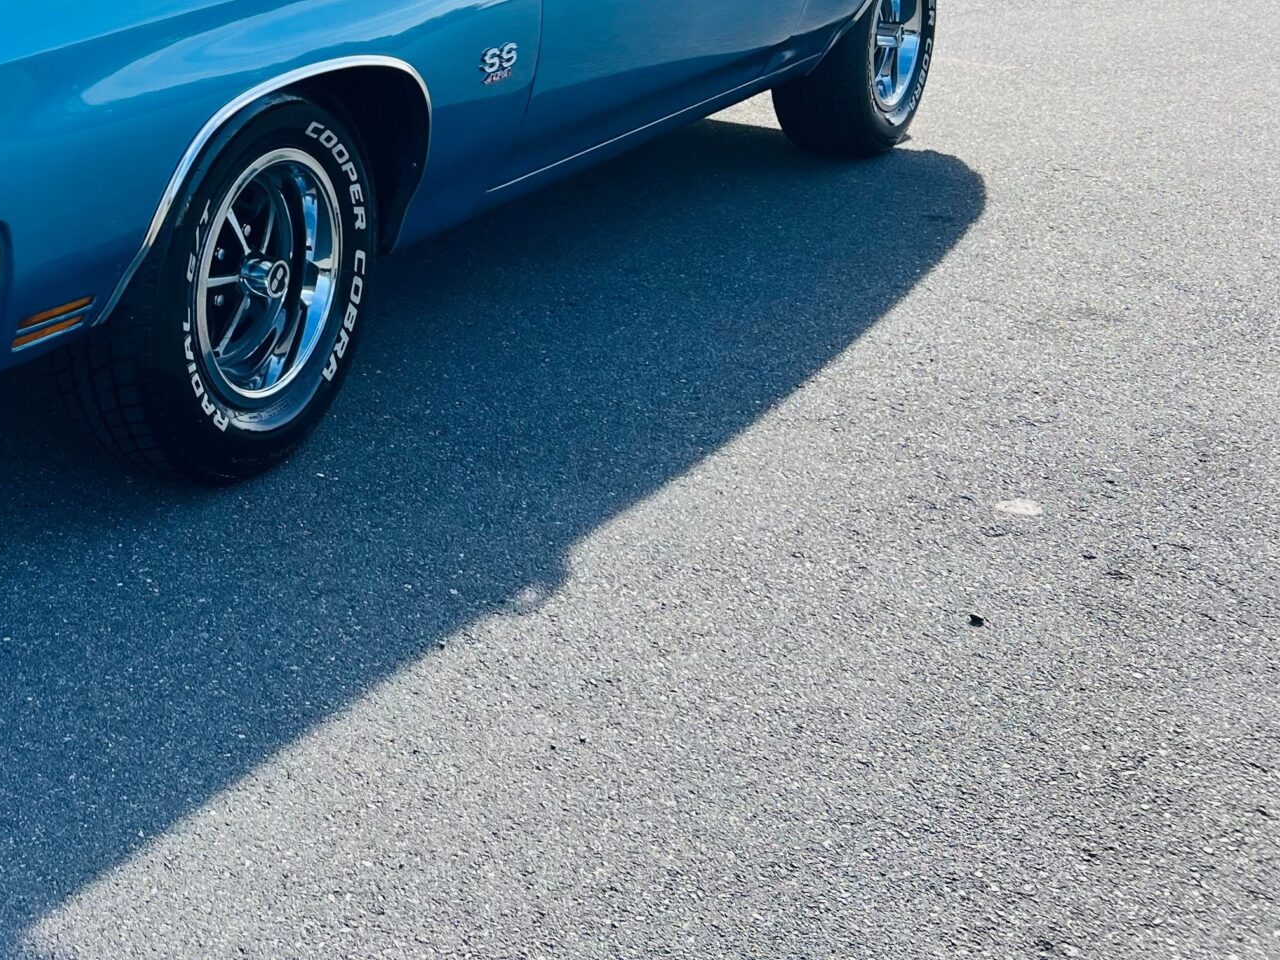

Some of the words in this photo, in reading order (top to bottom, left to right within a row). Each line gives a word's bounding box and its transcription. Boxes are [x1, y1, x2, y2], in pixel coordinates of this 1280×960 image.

[483, 42, 518, 73] SS
[908, 38, 933, 112] COBRA
[305, 121, 367, 231] COOPER
[182, 307, 230, 432] RADIAL
[321, 249, 366, 383] COBRA
